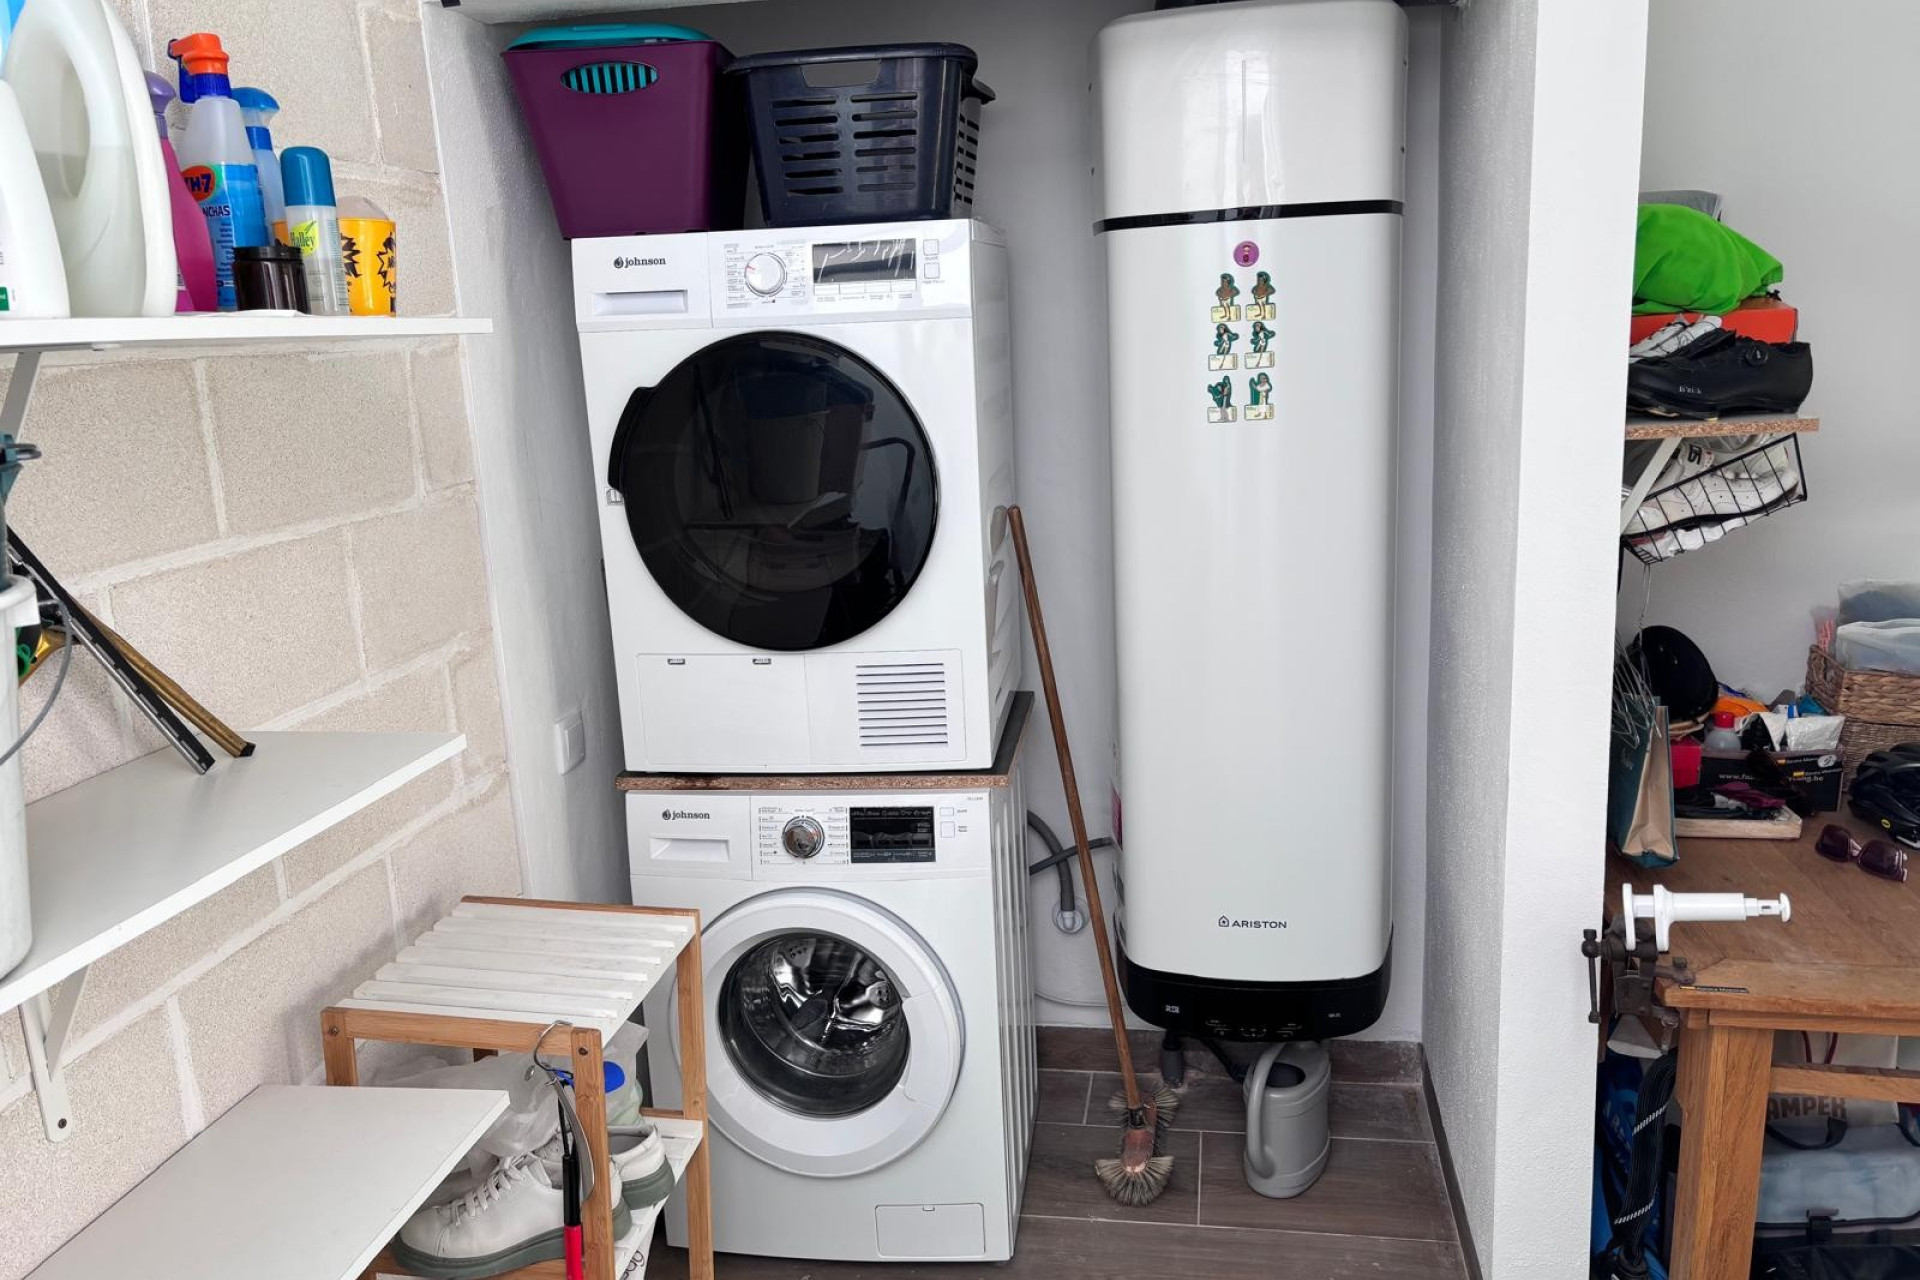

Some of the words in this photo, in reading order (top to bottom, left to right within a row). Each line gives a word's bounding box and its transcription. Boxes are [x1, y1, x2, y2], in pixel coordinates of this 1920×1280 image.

[202, 205, 231, 217] NCHAS
[624, 255, 667, 268] johnson
[672, 809, 711, 821] johnson
[1232, 919, 1288, 929] ARISTON
[1767, 1096, 1847, 1120] AMPER
